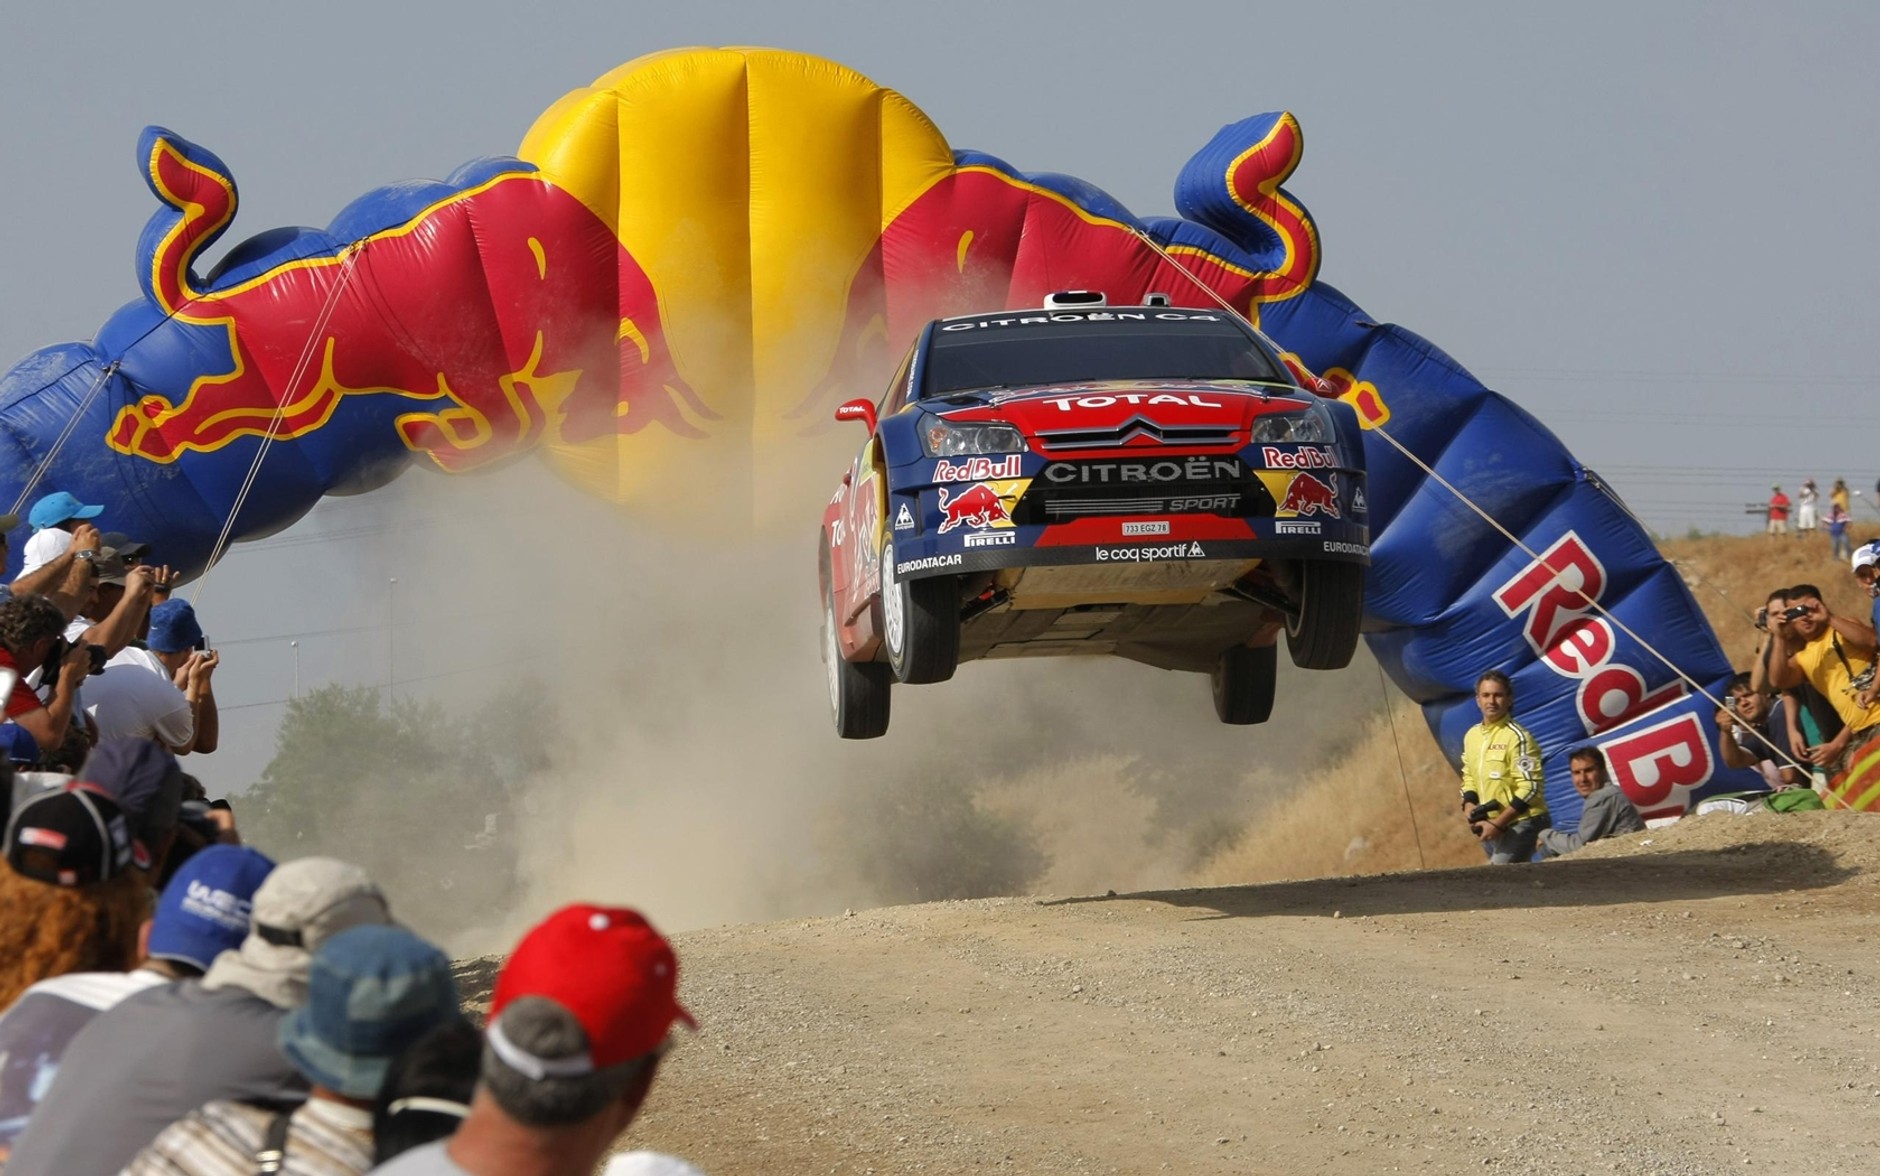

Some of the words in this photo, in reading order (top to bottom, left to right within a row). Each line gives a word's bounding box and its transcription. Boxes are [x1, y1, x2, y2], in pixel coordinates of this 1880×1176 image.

[942, 312, 1146, 331] CITROËN
[1155, 313, 1221, 322] C4
[839, 405, 866, 414] TOTAL
[1043, 395, 1222, 412] TOTAL
[1044, 456, 1240, 483] CITROËN
[1169, 497, 1240, 511] SPORT
[1126, 525, 1139, 534] 733
[1140, 524, 1156, 533] EGZ
[1157, 523, 1167, 532] 78
[1275, 521, 1321, 534] PIRELLI
[963, 531, 1016, 547] PIRELLI
[1096, 547, 1109, 560] le
[1110, 548, 1140, 562] coq
[1141, 543, 1187, 562] sportif
[897, 554, 962, 574] EURODATACAR
[1491, 529, 1693, 739] Red
